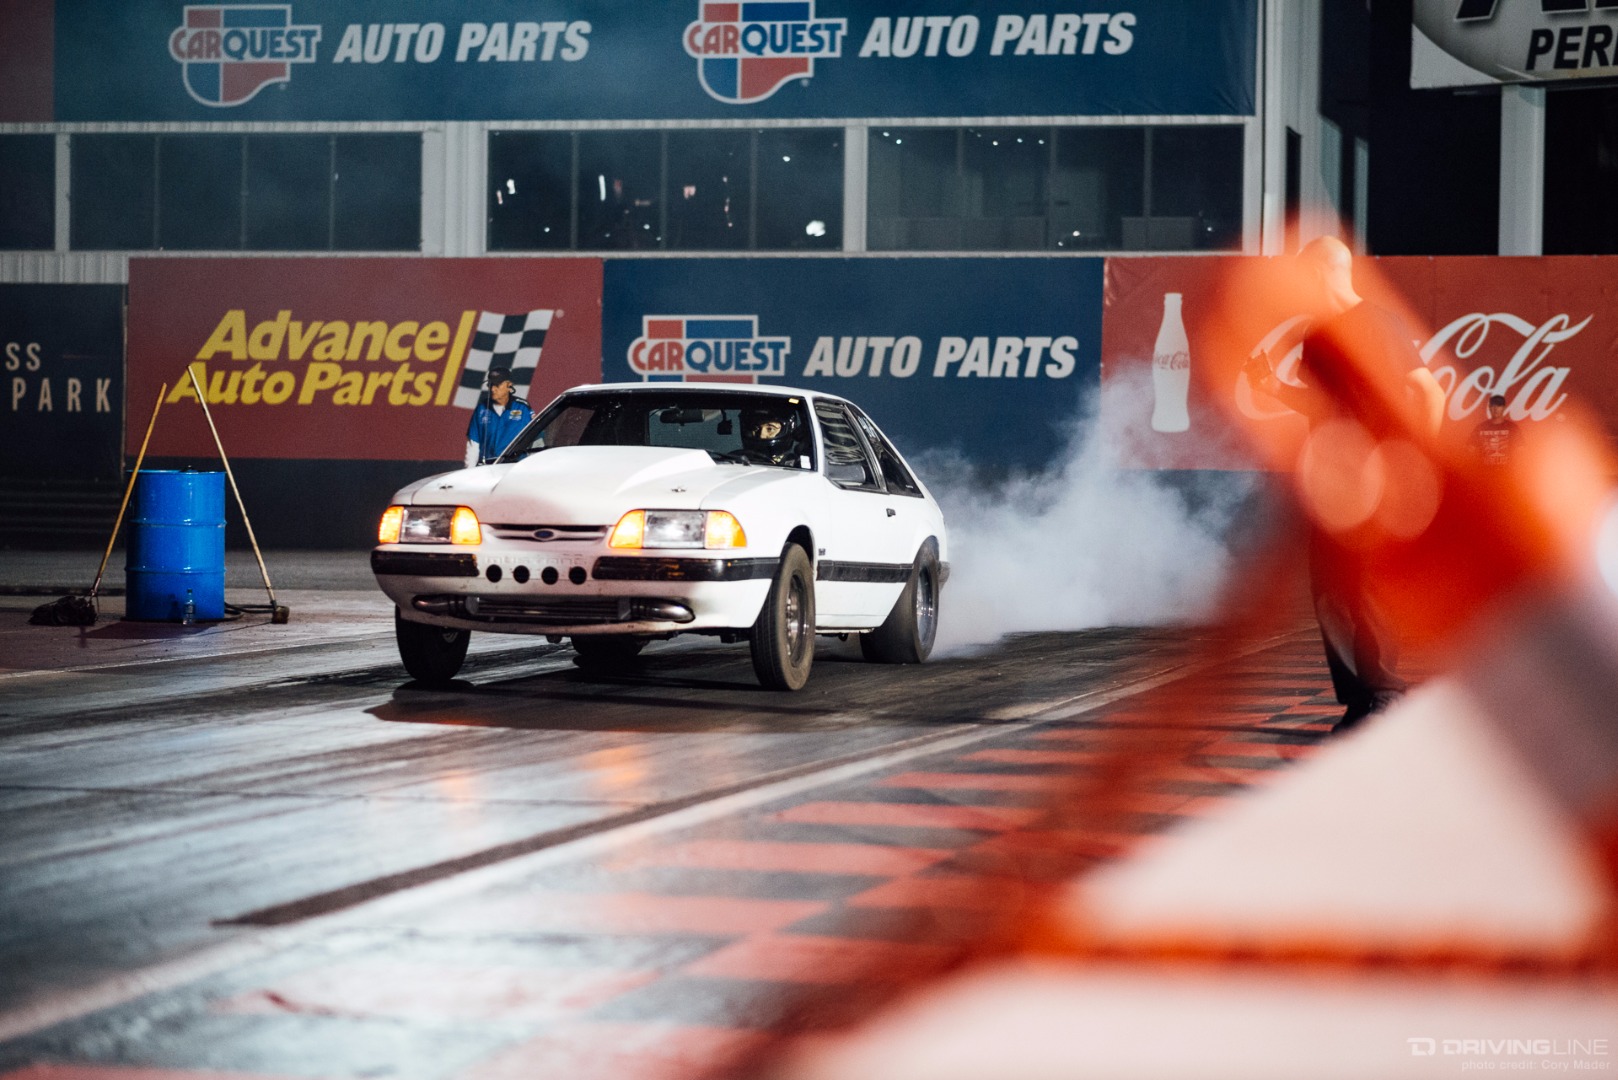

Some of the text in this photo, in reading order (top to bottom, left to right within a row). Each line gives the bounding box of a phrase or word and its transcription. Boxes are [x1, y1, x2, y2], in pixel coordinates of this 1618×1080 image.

[171, 20, 593, 64] CARQUEST AUTO PARTS
[687, 12, 1137, 58] CARQUEST AUTO PARTS
[1525, 25, 1618, 71] PER
[5, 342, 41, 371] SS
[195, 309, 451, 362] Advance
[632, 335, 1079, 379] CARQUEST AUTO PARTS
[12, 377, 111, 412] PARK
[166, 361, 438, 407] Auto Parts
